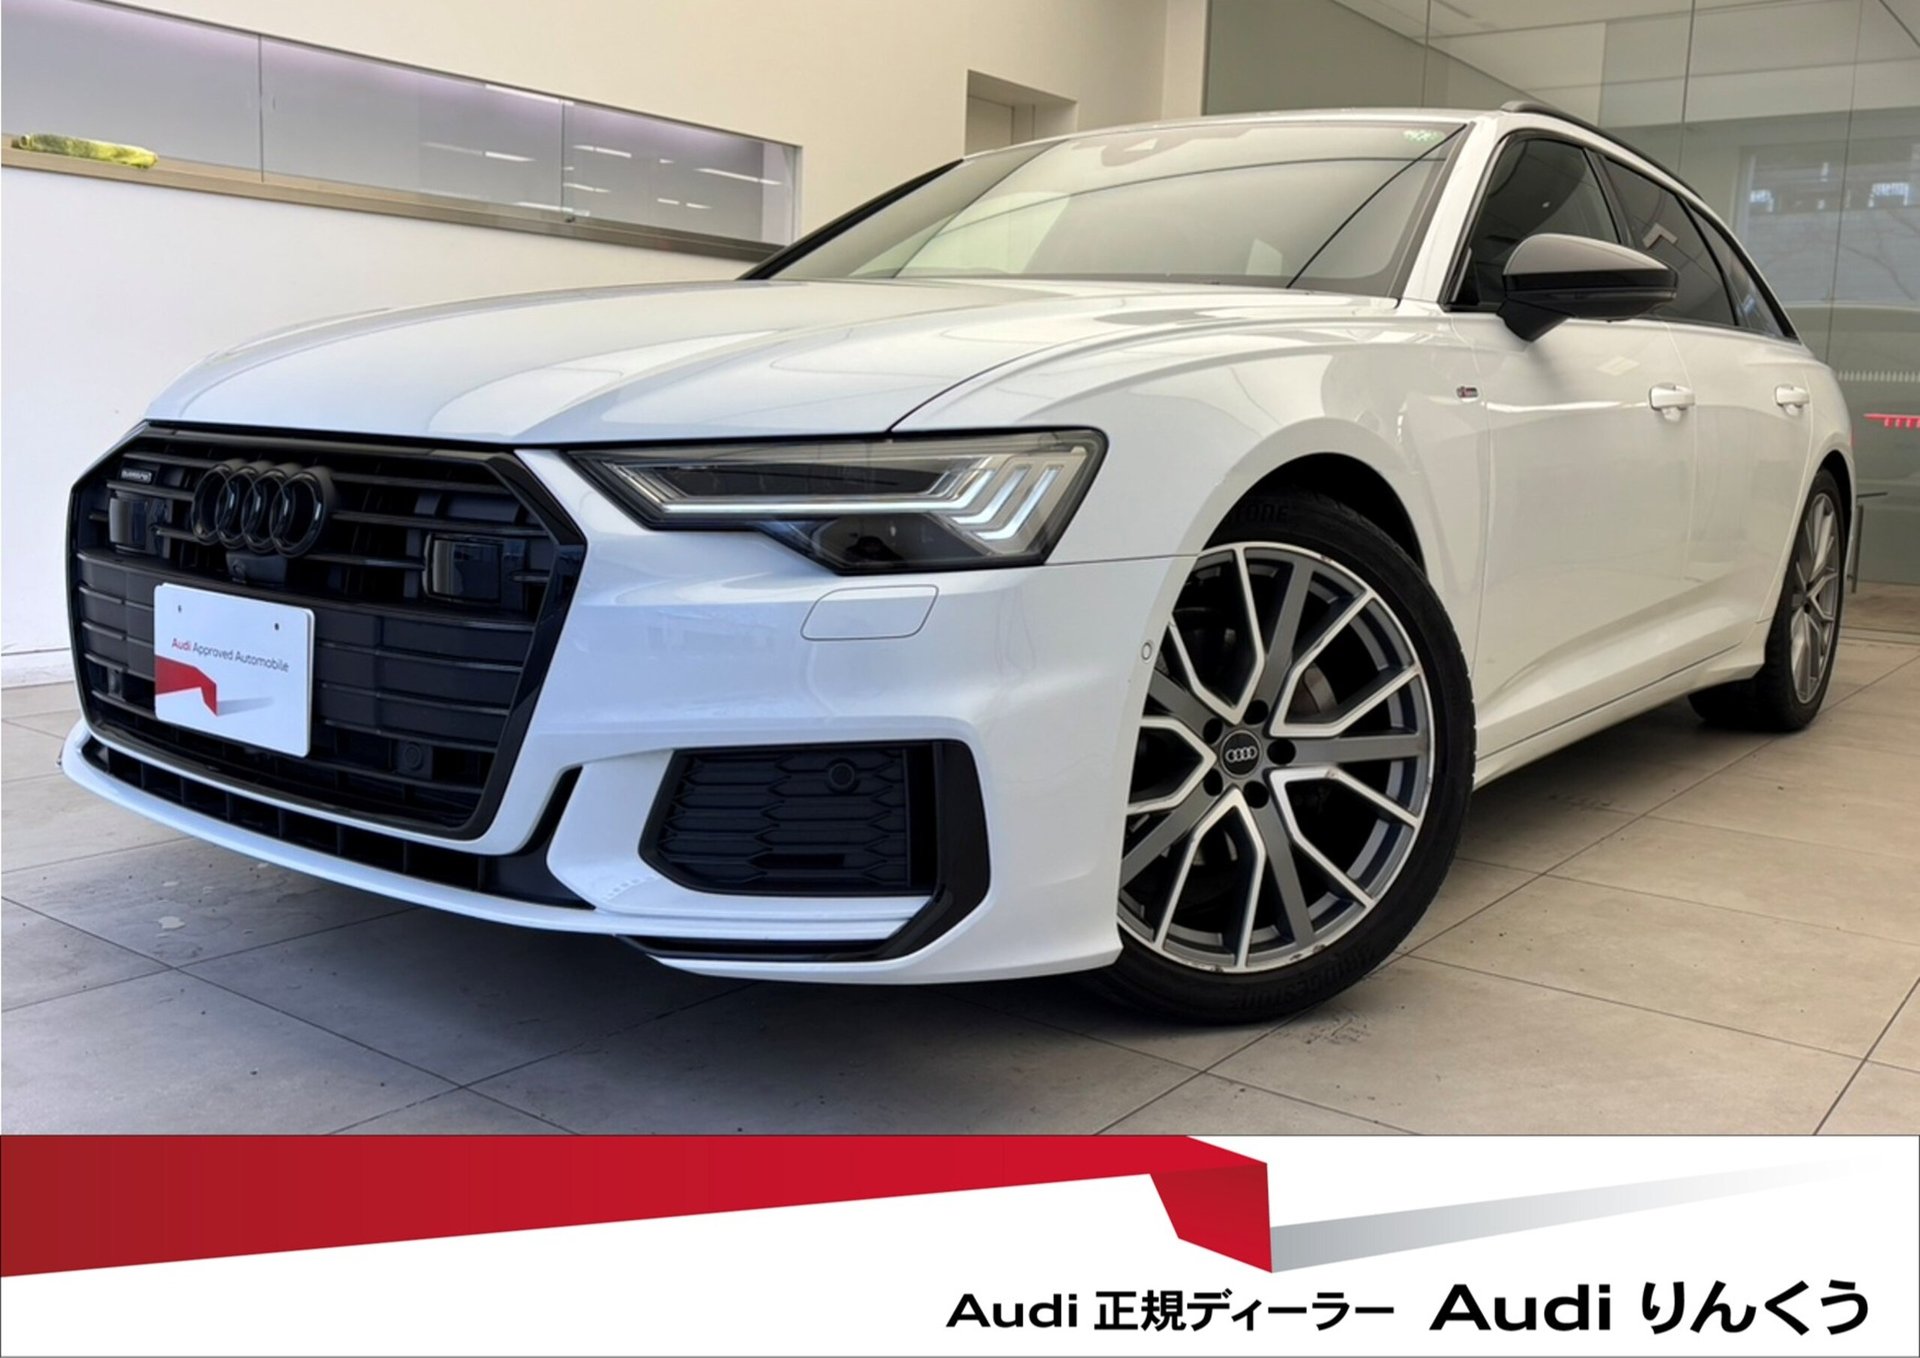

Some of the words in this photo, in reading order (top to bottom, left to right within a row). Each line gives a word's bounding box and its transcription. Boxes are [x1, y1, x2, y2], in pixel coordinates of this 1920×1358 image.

[171, 638, 191, 651] Audi
[193, 642, 234, 661] Approved
[235, 651, 289, 672] Automobile
